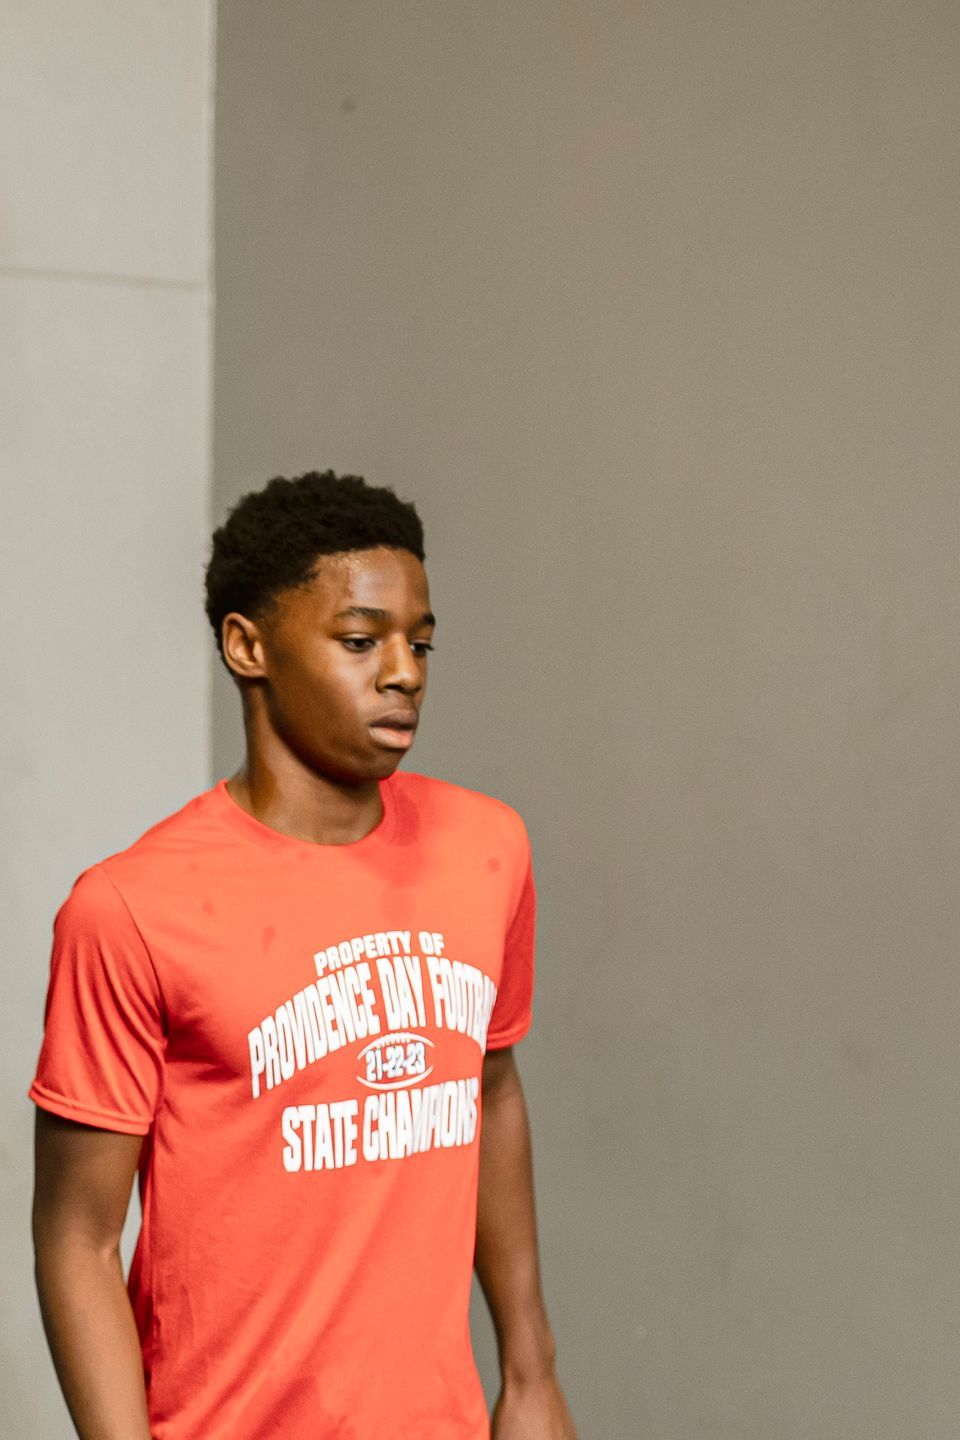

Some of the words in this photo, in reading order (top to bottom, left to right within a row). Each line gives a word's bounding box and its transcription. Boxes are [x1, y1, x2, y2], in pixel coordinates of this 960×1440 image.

[314, 931, 411, 977] PROPERTY
[419, 931, 444, 956] OF
[248, 961, 381, 1100] PROVIDENCE
[376, 956, 426, 1030] DAY
[366, 1042, 426, 1082] 21-22-23
[282, 1099, 358, 1172] STATE
